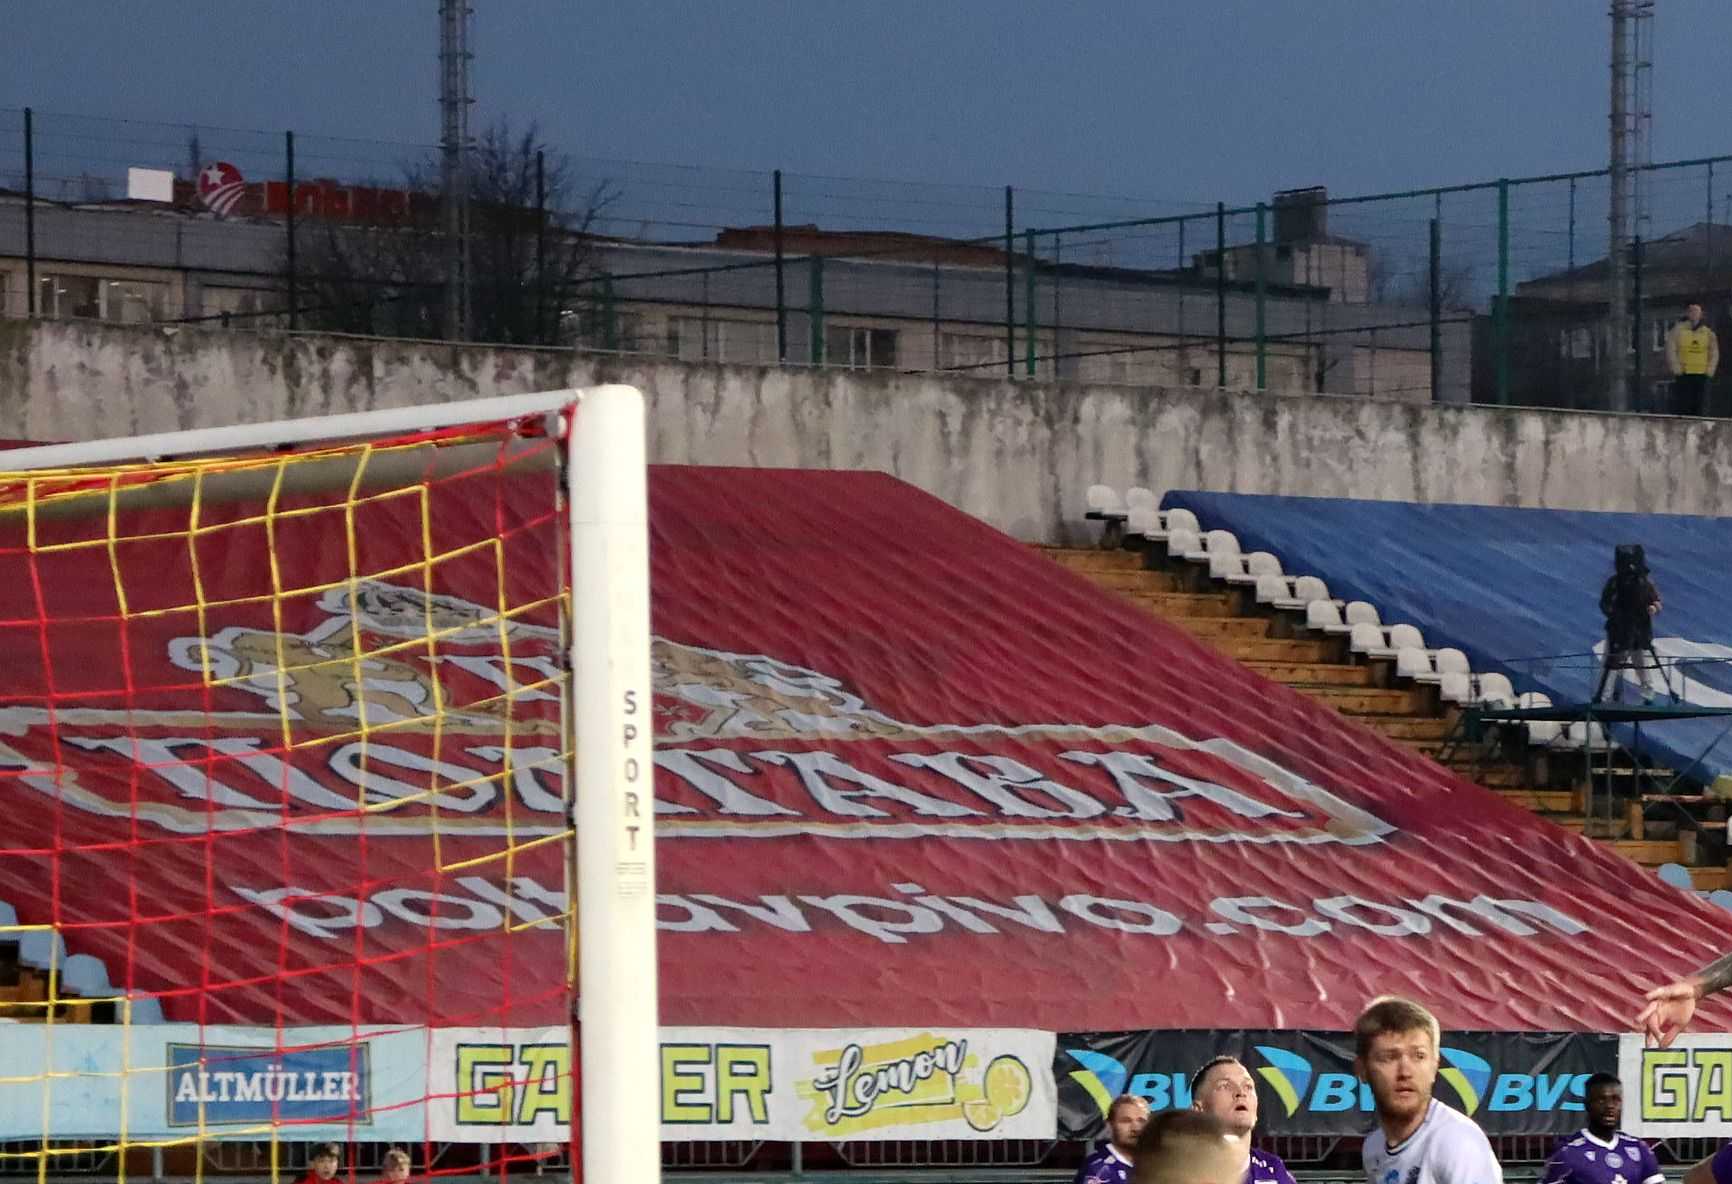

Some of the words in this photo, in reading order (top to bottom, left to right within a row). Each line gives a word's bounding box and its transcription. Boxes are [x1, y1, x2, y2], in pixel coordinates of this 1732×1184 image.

[622, 690, 641, 851] SPORT
[174, 1065, 362, 1102] ALTMÜLLER
[456, 1043, 772, 1125] GAER
[813, 1039, 968, 1125] Lemon
